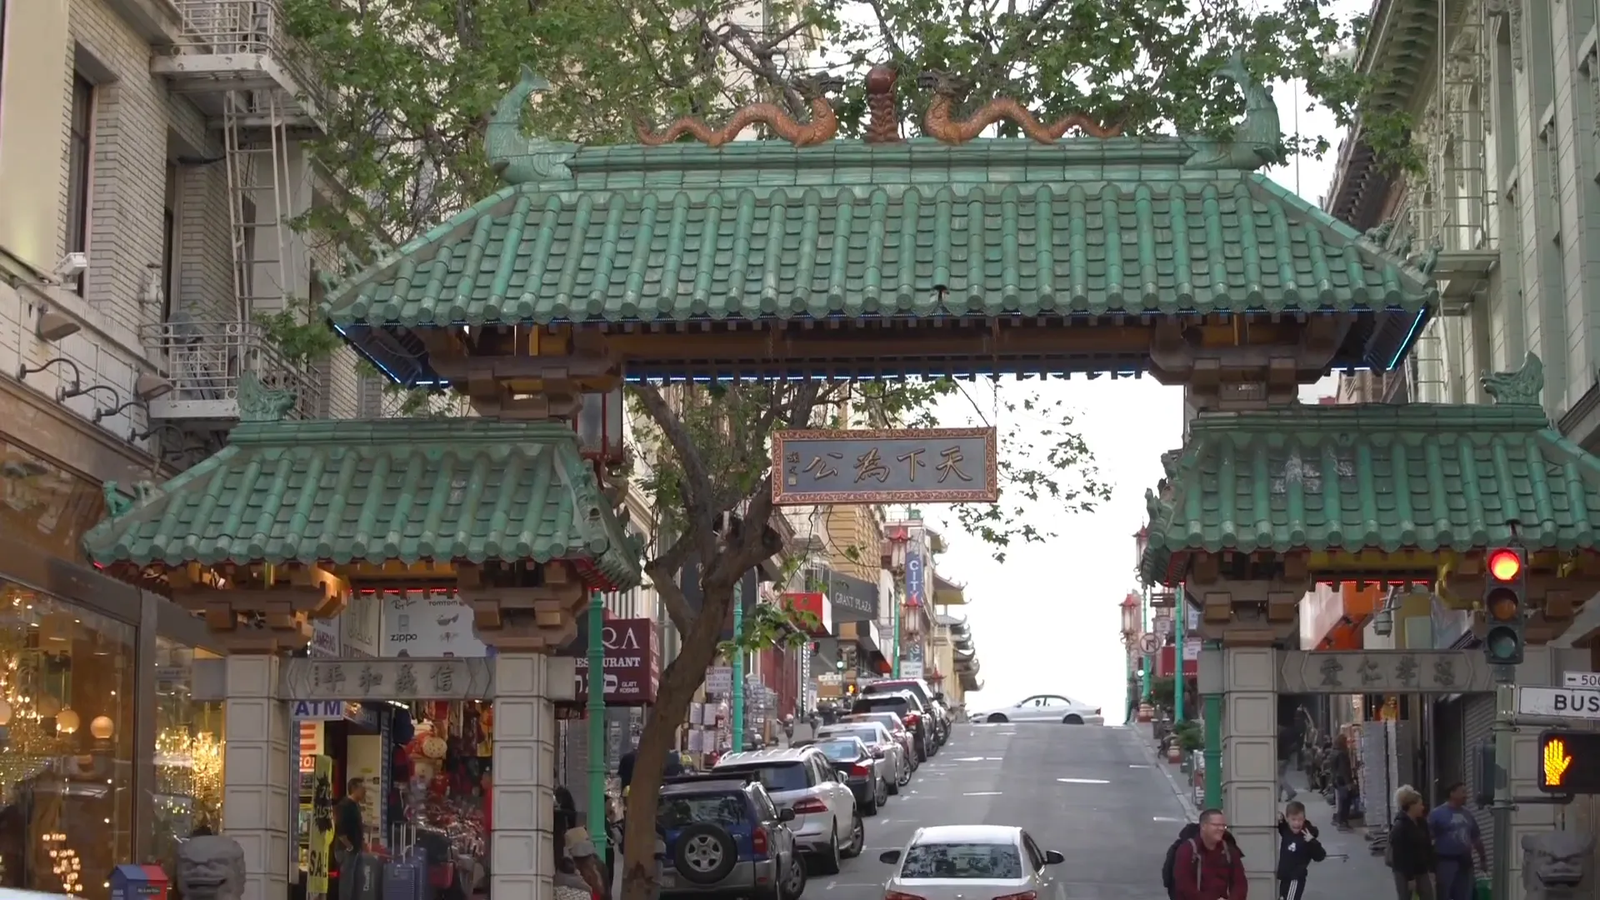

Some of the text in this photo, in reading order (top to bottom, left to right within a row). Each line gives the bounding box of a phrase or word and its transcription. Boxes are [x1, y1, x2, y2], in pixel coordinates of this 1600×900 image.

[802, 445, 973, 484] 天下為公
[909, 561, 919, 600] CITY
[835, 592, 872, 613] GRANT PLAZA
[390, 634, 417, 643] zippo
[576, 657, 640, 667] ESURANT
[295, 702, 341, 716] ATM
[1554, 694, 1600, 712] BUS
